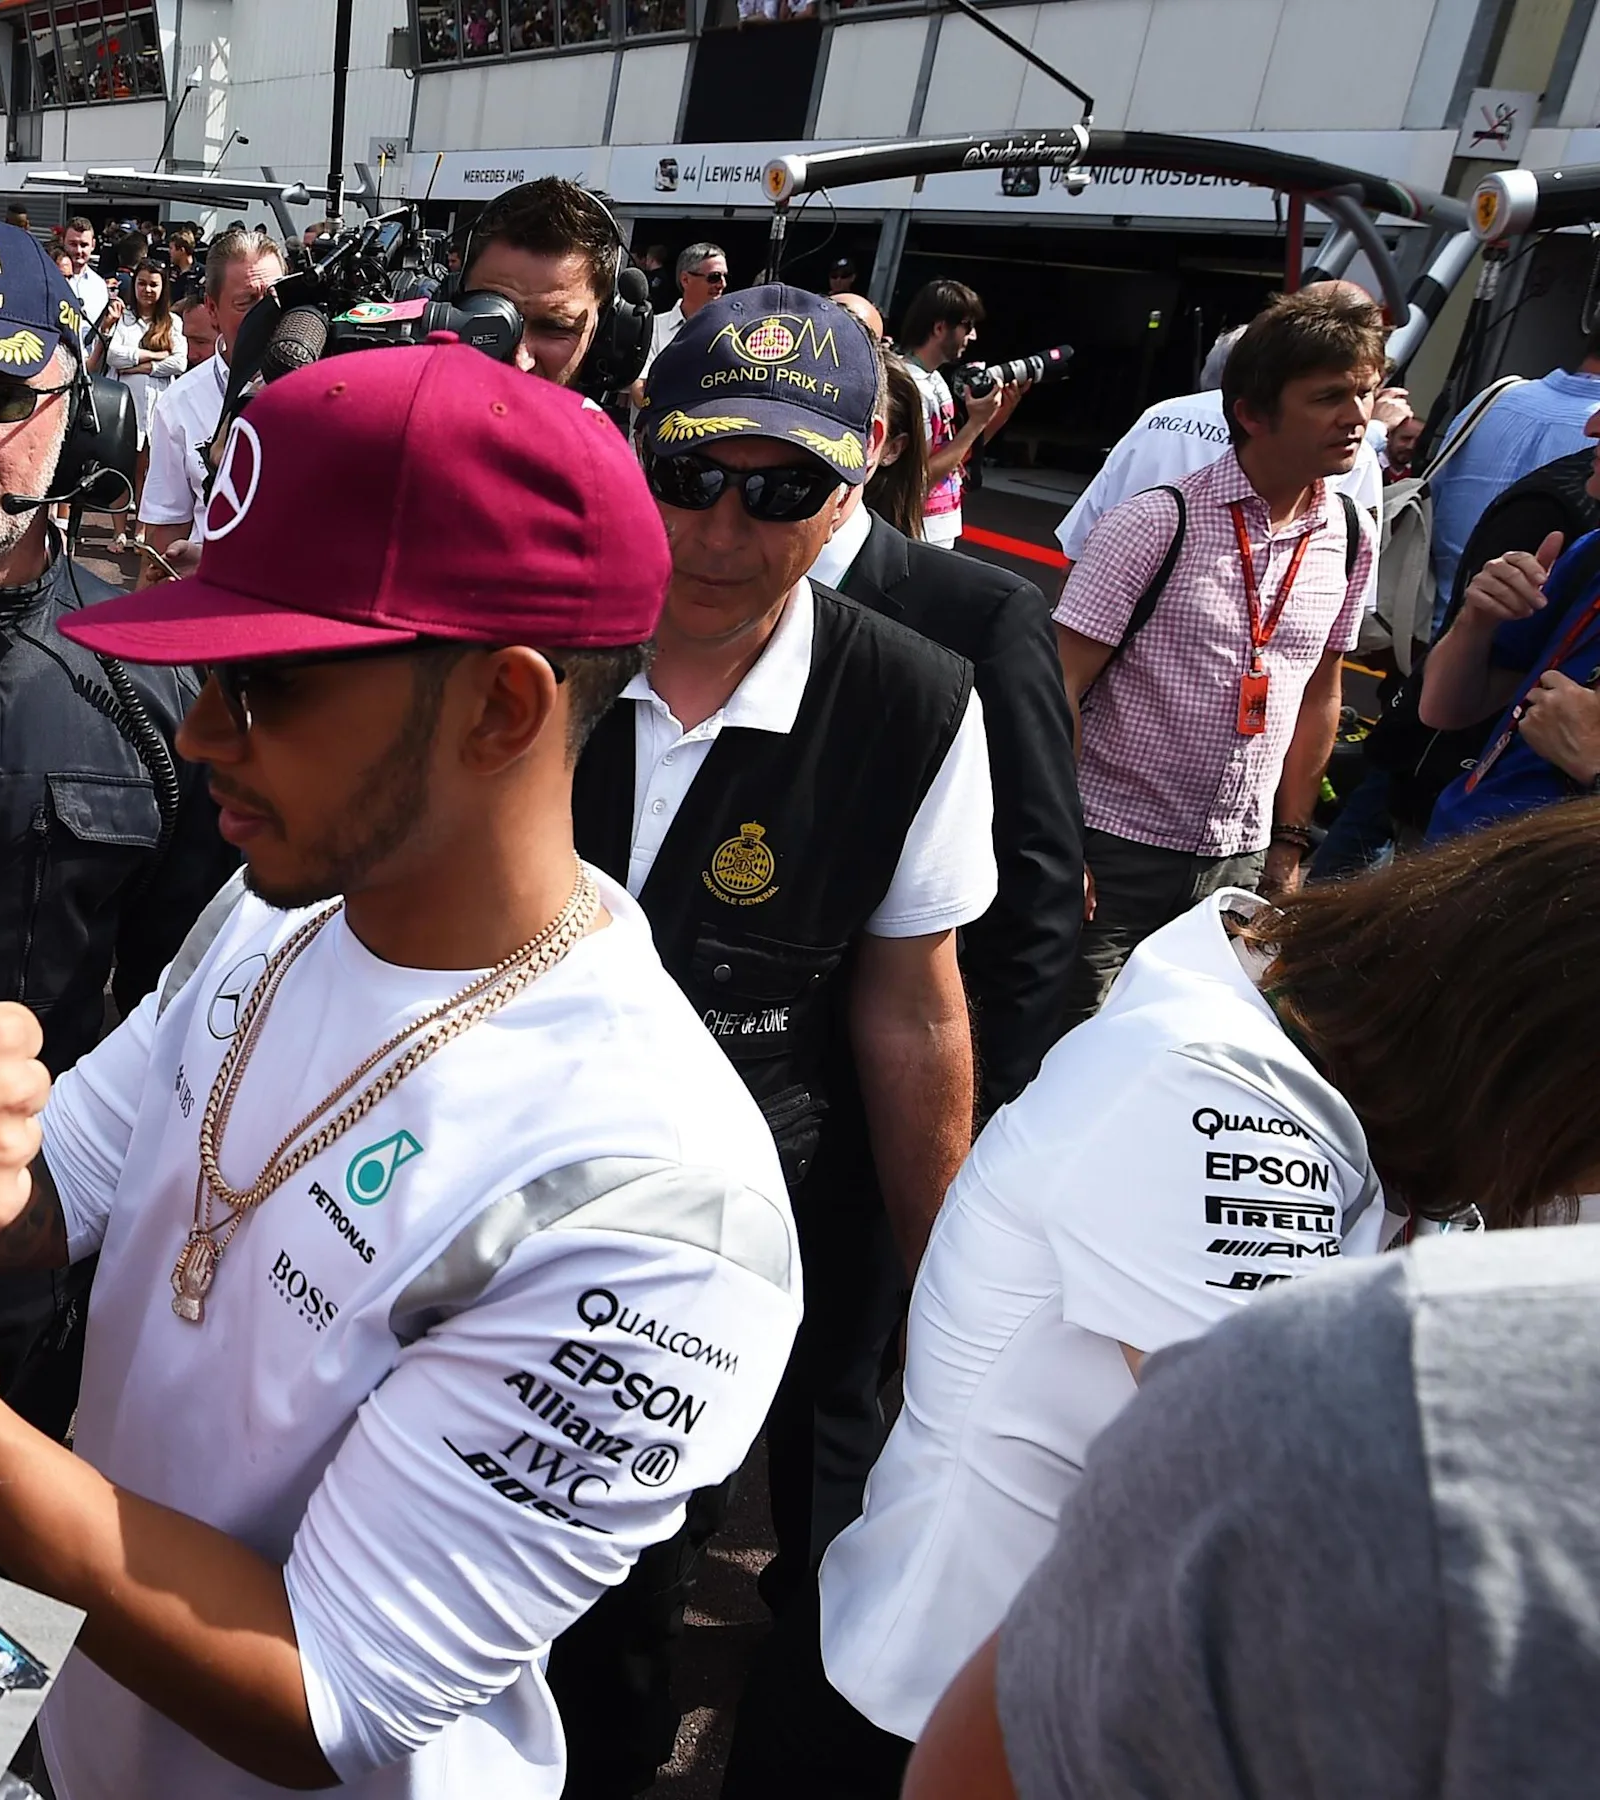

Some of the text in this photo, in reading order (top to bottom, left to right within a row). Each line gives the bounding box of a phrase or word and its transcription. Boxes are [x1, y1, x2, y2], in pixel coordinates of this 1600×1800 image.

[463, 169, 525, 183] MERCEDES AMG
[683, 168, 697, 182] 44
[705, 166, 743, 182] LEWIS
[701, 366, 841, 403] GRAND PRIX F1
[701, 870, 779, 906] CONTROLE GENERAL
[757, 1007, 789, 1033] ZONE
[1206, 1151, 1329, 1192] EPSON
[308, 1181, 376, 1265] PETRONAS
[1204, 1195, 1336, 1233] PIRELLI
[272, 1249, 339, 1328] BOSS
[549, 1340, 707, 1434] EPSON
[503, 1370, 635, 1464] Allianz
[499, 1431, 611, 1508] IWC
